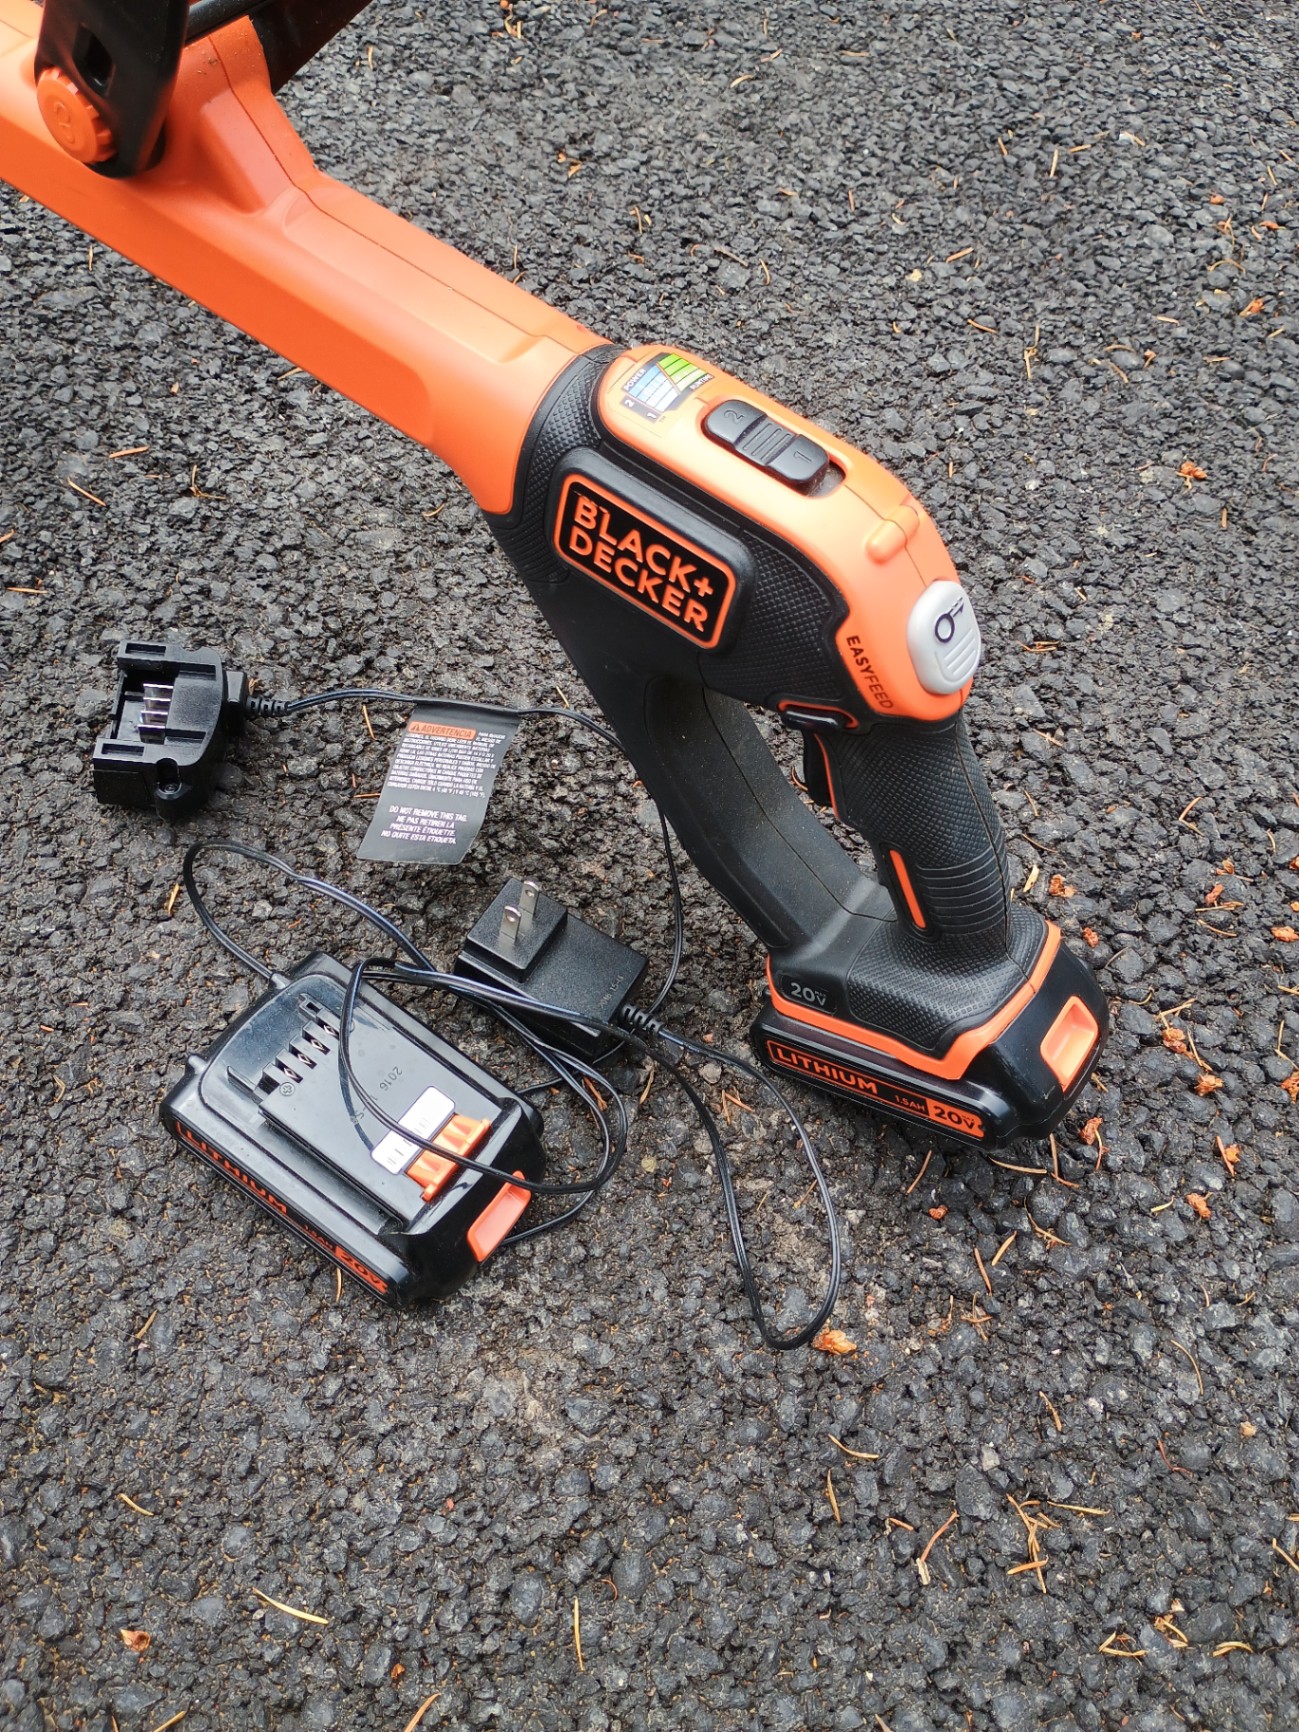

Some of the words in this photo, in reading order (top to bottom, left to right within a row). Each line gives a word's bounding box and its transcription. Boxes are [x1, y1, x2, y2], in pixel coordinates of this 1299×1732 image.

[622, 368, 646, 391] POWER
[624, 399, 635, 408] 2
[723, 409, 745, 424] 2
[792, 450, 812, 463] 1
[573, 494, 714, 597] BLACK+
[569, 525, 708, 632] DECKER
[846, 635, 894, 709] EASYFEED
[420, 724, 473, 738] ADVERTENCIA
[389, 805, 399, 813] DO
[399, 806, 413, 815] NOT
[413, 808, 439, 818] REMOVE
[440, 811, 455, 820] THIS
[406, 816, 419, 824] PAS
[446, 821, 455, 829] LA
[391, 831, 410, 840] QUITE
[410, 833, 426, 842] ESTA
[379, 1066, 402, 1091] 2016
[776, 1047, 878, 1095] LITHIUM
[894, 1095, 925, 1111] 1.5AH
[933, 1105, 975, 1129] 20V
[185, 1129, 287, 1215] LITHIUM
